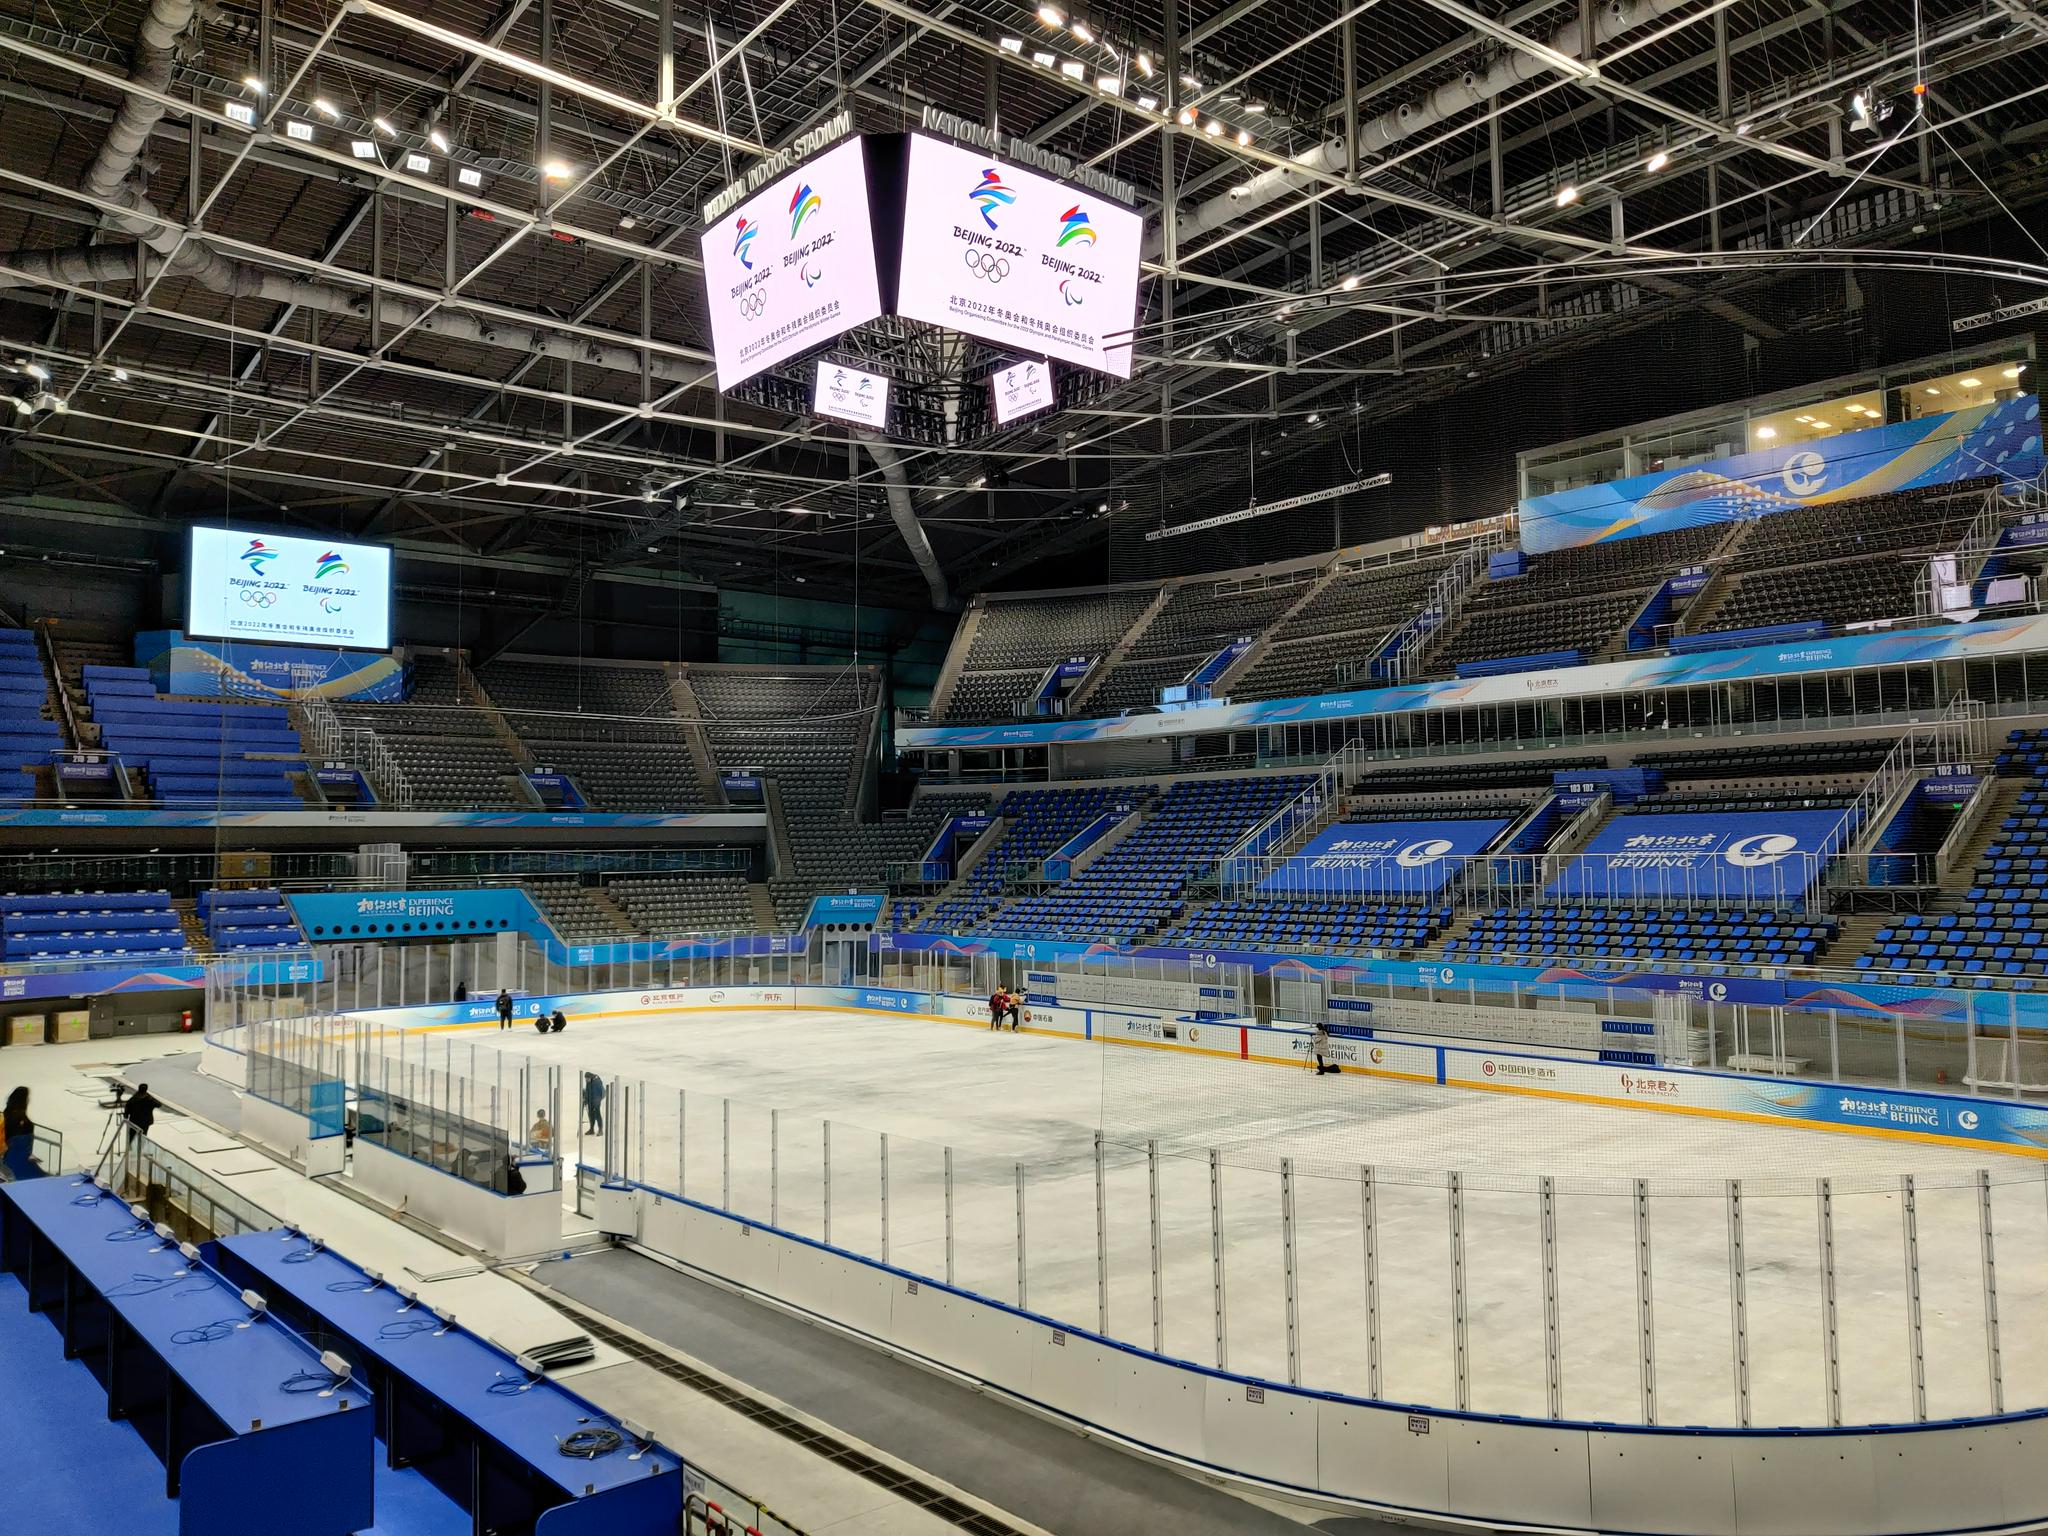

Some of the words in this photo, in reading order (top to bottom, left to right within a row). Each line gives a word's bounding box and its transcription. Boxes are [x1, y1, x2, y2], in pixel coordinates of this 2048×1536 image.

[921, 105, 1005, 155] NATIONAL
[1010, 137, 1072, 179] INDOOR
[1074, 164, 1136, 205] STADIUM
[703, 178, 748, 225] NATIONAL
[748, 148, 791, 192] INDOOR
[793, 110, 853, 162] STADIUM
[953, 225, 993, 249] BEIJING
[994, 239, 1024, 257] 2022
[783, 244, 810, 268] BEIJING
[811, 232, 834, 253] 2022
[1041, 253, 1076, 276] BEIJING
[1077, 267, 1103, 284] 2022
[731, 278, 753, 299] BEIJING
[754, 266, 773, 286] 2022
[950, 295, 1095, 345] 北京2022年冬奥会和冬残奥会组织委员会
[229, 577, 261, 588] BEIJING
[263, 581, 289, 590] 2022
[302, 584, 333, 595] BEIJING
[334, 588, 358, 596] 2022
[1937, 765, 1952, 776] 102
[1956, 764, 1971, 775] 101
[1570, 784, 1580, 793] 103
[1582, 783, 1594, 792] 102
[1328, 838, 1398, 851] 相约北京
[1624, 833, 1718, 848] 相约北京
[1310, 858, 1373, 868] BEIJING
[1608, 857, 1698, 868] BEIJING
[356, 897, 407, 913] 相约北京
[408, 898, 454, 906] EXPERIENCE
[408, 905, 454, 917] BEIJING
[1033, 1014, 1053, 1023] 中国石油
[1127, 1021, 1152, 1031] 相约北京
[1636, 1077, 1679, 1093] 北京君太
[1839, 1097, 1889, 1114] 相约北京
[1890, 1103, 1938, 1115] EXPERIENCE
[1890, 1111, 1939, 1126] BEIJING
